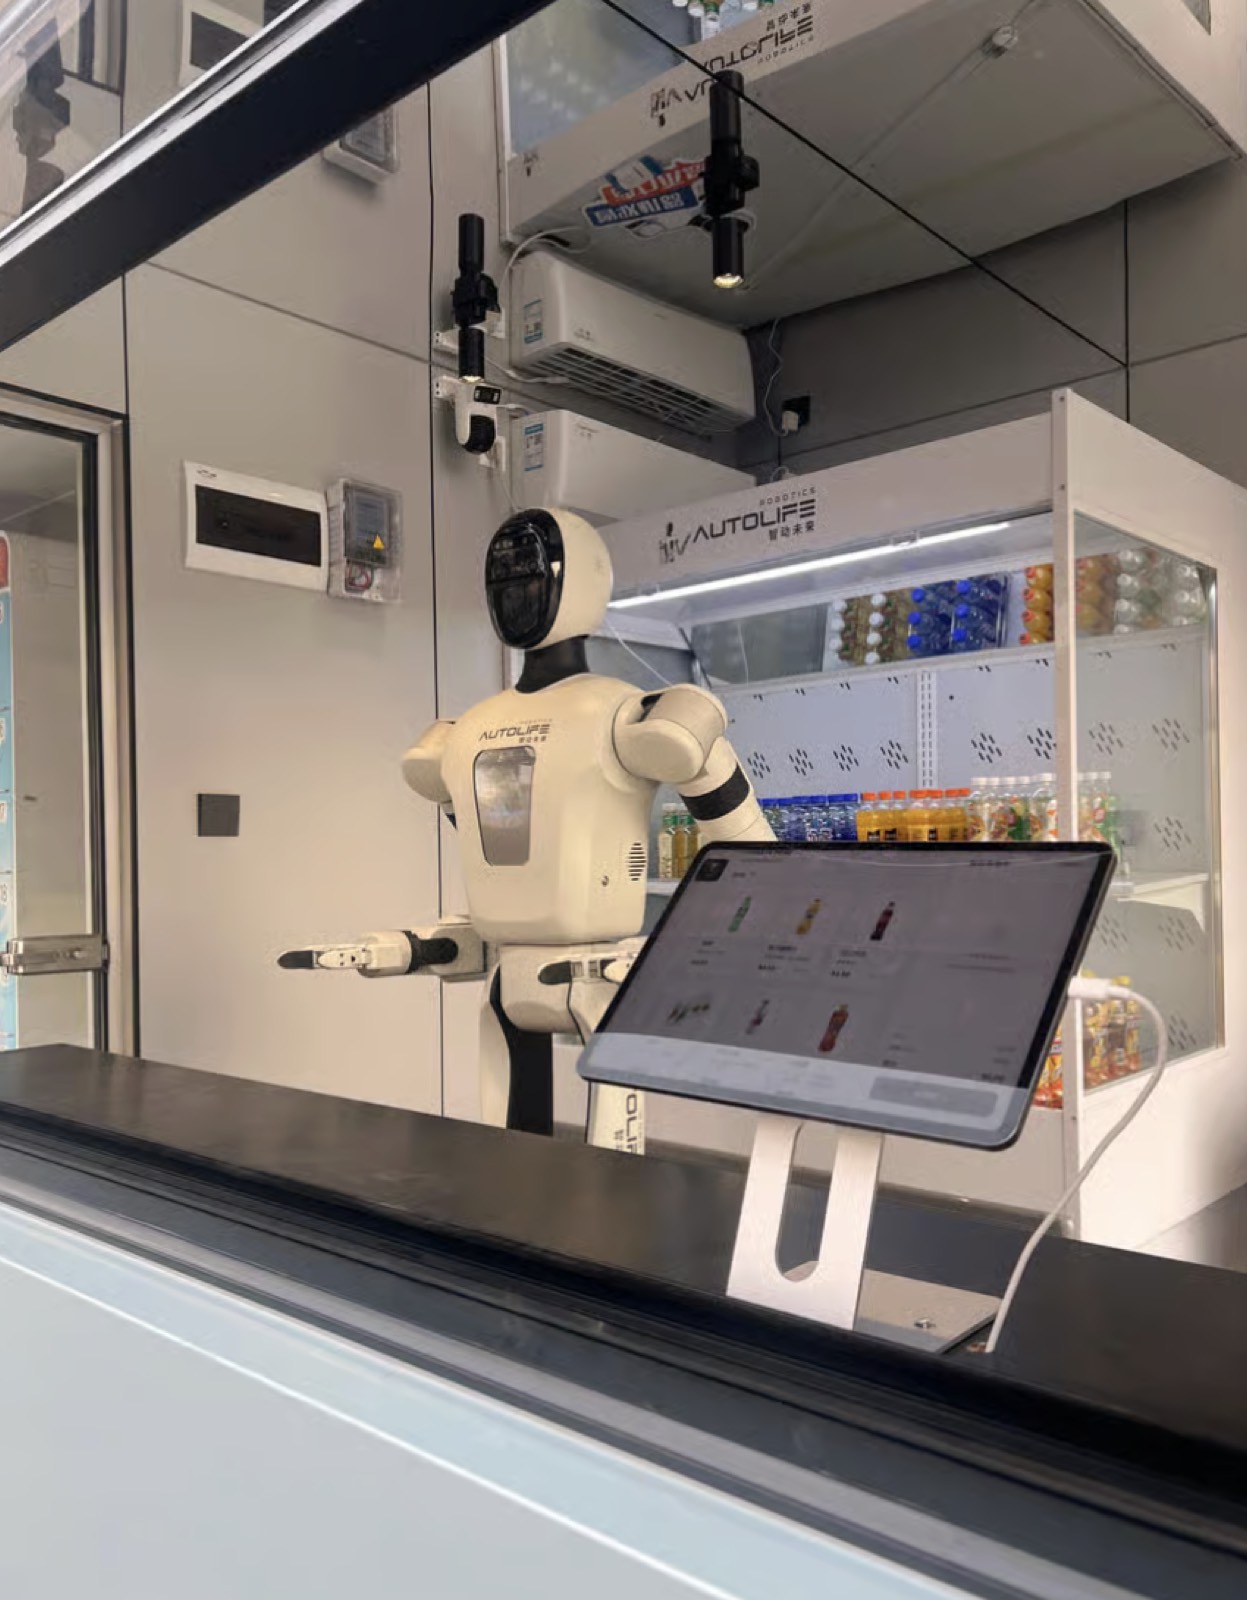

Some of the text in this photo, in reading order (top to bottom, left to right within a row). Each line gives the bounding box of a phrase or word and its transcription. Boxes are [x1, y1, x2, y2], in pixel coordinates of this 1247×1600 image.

[759, 487, 816, 505] ROBOTICS
[693, 498, 816, 543] AUTOLIFE
[478, 724, 551, 741] AUTOLIFE
